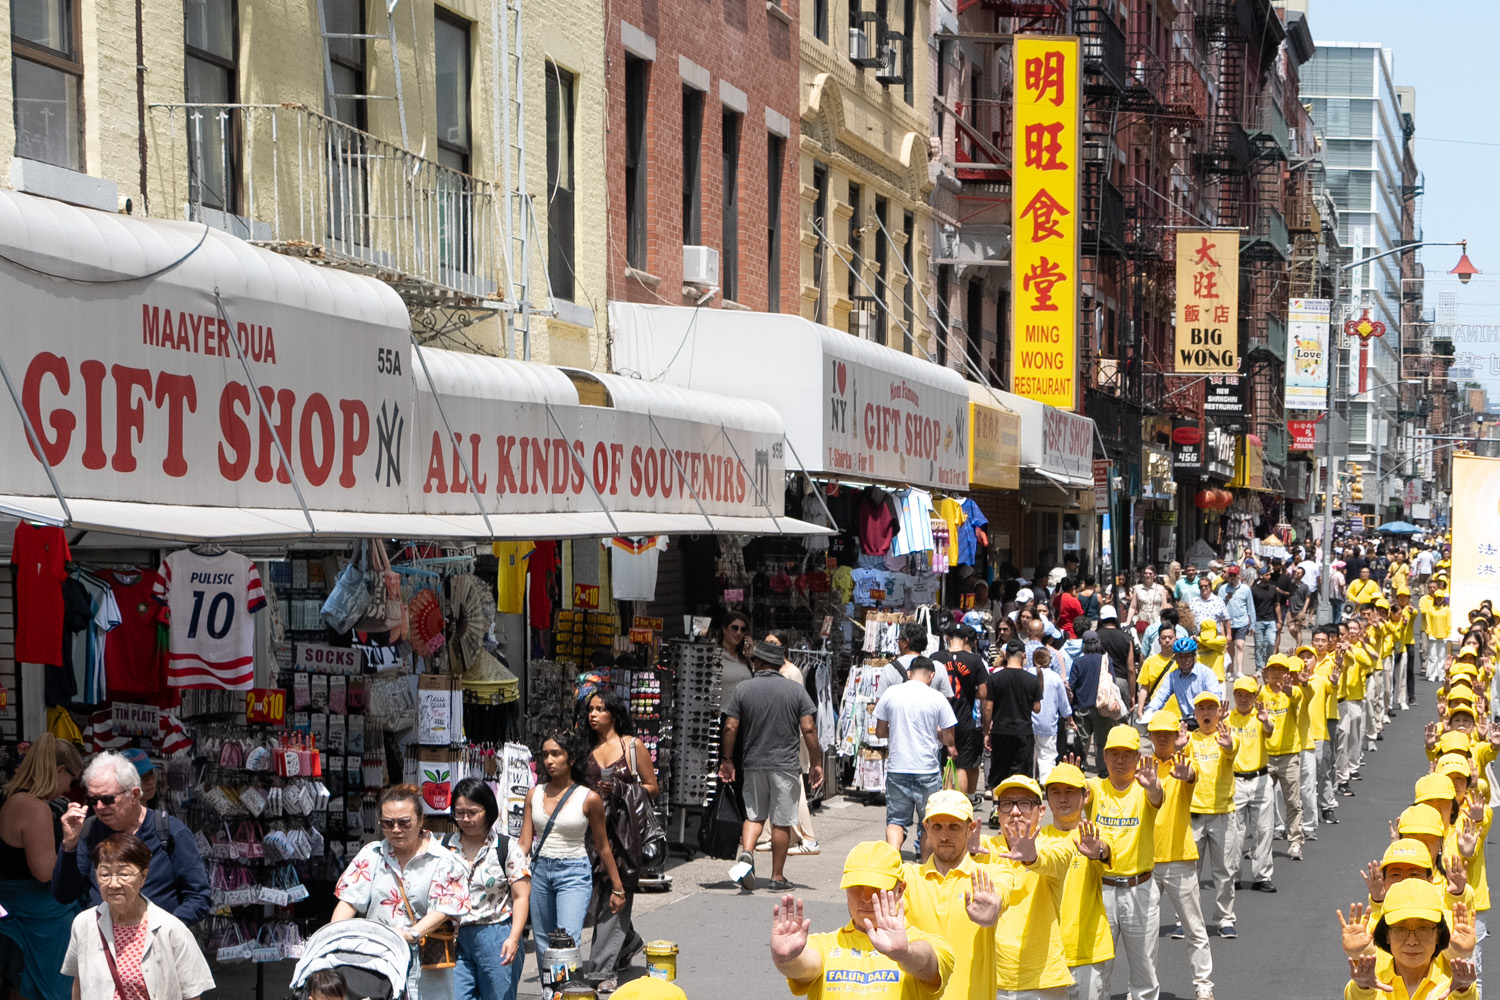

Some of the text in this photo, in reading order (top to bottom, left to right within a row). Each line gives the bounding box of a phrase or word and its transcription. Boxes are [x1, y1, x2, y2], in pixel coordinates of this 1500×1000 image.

[1019, 50, 1071, 312] 明旺食堂
[1193, 236, 1220, 299] 大旺
[1184, 304, 1230, 323] 飯店
[142, 304, 276, 364] MAAYER DUA
[1025, 325, 1060, 343] MING
[1190, 328, 1222, 345] BIG
[377, 348, 401, 376] 55A
[1021, 351, 1064, 370] WONG
[1180, 350, 1233, 368] WONG
[1297, 349, 1322, 359] Love
[1014, 377, 1071, 396] RESTAURANT
[831, 397, 847, 434] NY
[1203, 403, 1243, 411] RESTAURANT
[22, 351, 370, 488] GIFT SHOP
[864, 402, 901, 454] GIFT
[904, 411, 942, 461] SHOP
[1048, 411, 1068, 454] GIFT
[1069, 417, 1090, 458] SHOP
[423, 430, 746, 504] ALL KINDS OF SOUVENIRS
[828, 447, 852, 470] T-Shirts
[858, 452, 867, 472] For
[1179, 453, 1197, 462] 456
[190, 572, 235, 585] PULISIC
[575, 586, 580, 605] 2
[586, 587, 599, 606] $10
[187, 590, 235, 640] 10
[634, 631, 644, 641] for
[305, 648, 354, 666] SOCKS
[115, 707, 157, 723] TIN PLATE
[247, 692, 284, 719] 2 FOR $10
[828, 971, 896, 982] FALUN DAFA
